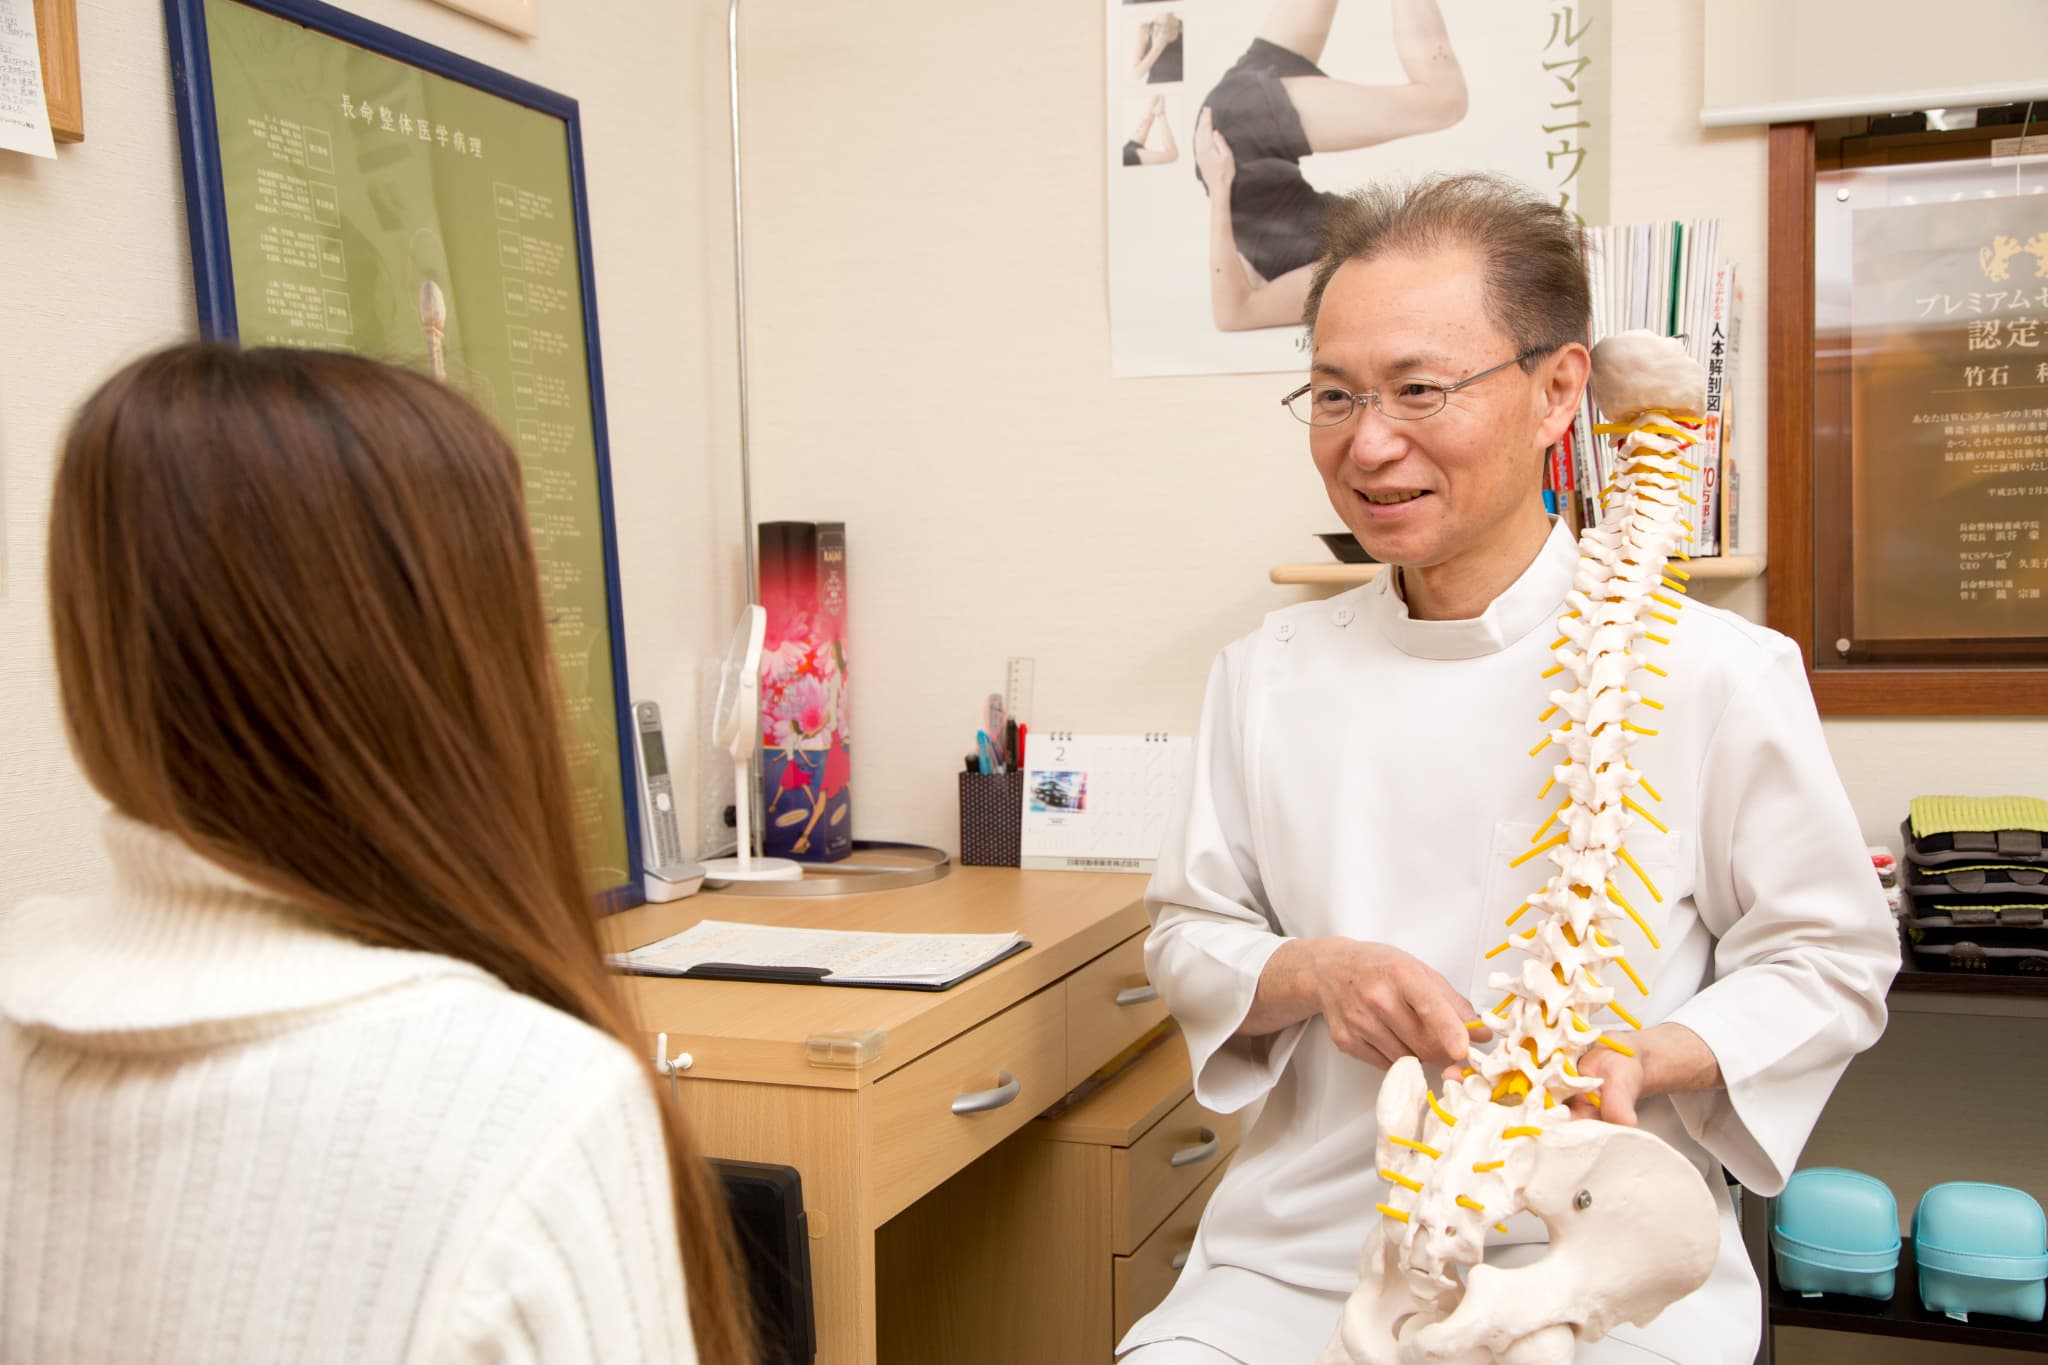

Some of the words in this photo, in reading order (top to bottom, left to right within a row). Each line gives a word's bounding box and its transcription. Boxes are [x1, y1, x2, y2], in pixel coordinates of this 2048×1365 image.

[341, 93, 483, 158] 長命整体医学病理
[1967, 317, 2048, 351] 認定
[1963, 365, 2009, 387] 竹石
[1055, 746, 1066, 762] 2
